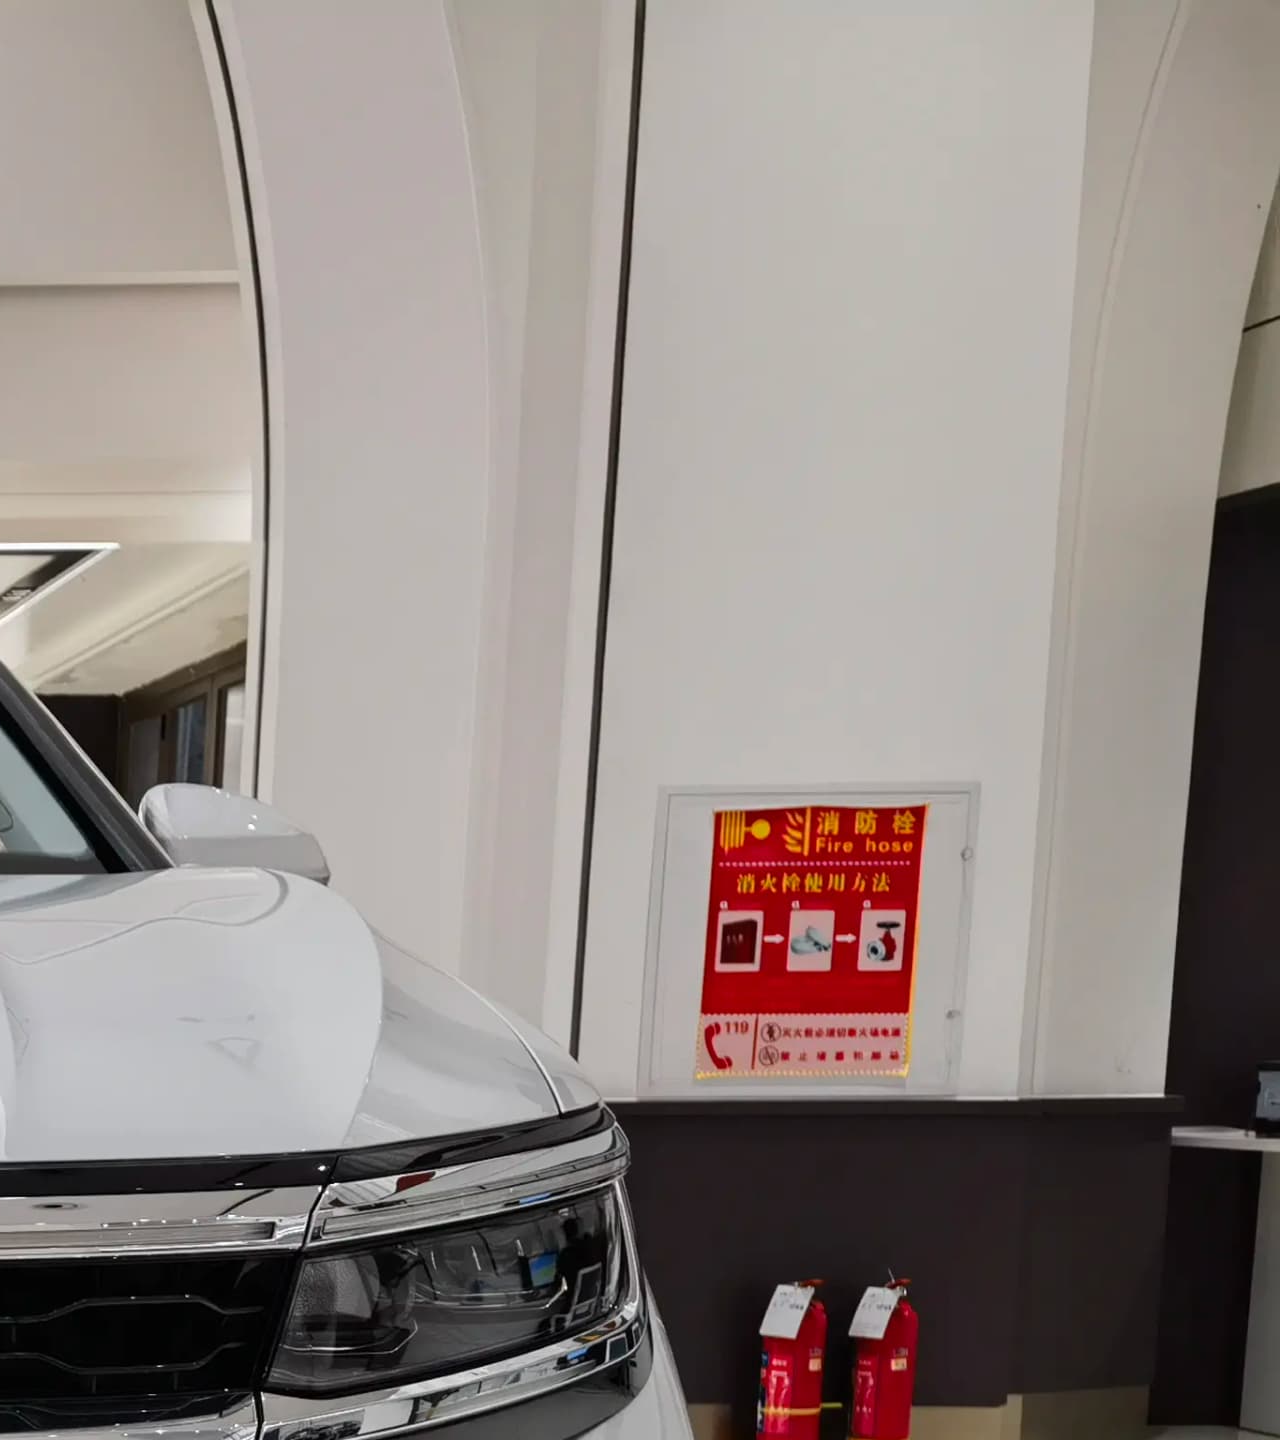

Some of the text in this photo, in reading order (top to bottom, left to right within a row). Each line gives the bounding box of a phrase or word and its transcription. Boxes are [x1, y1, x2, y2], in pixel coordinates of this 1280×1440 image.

[816, 810, 916, 835] 消防栓
[815, 837, 914, 853] Fire hose
[736, 872, 890, 894] 消火栓使用方法
[724, 1021, 749, 1034] 119
